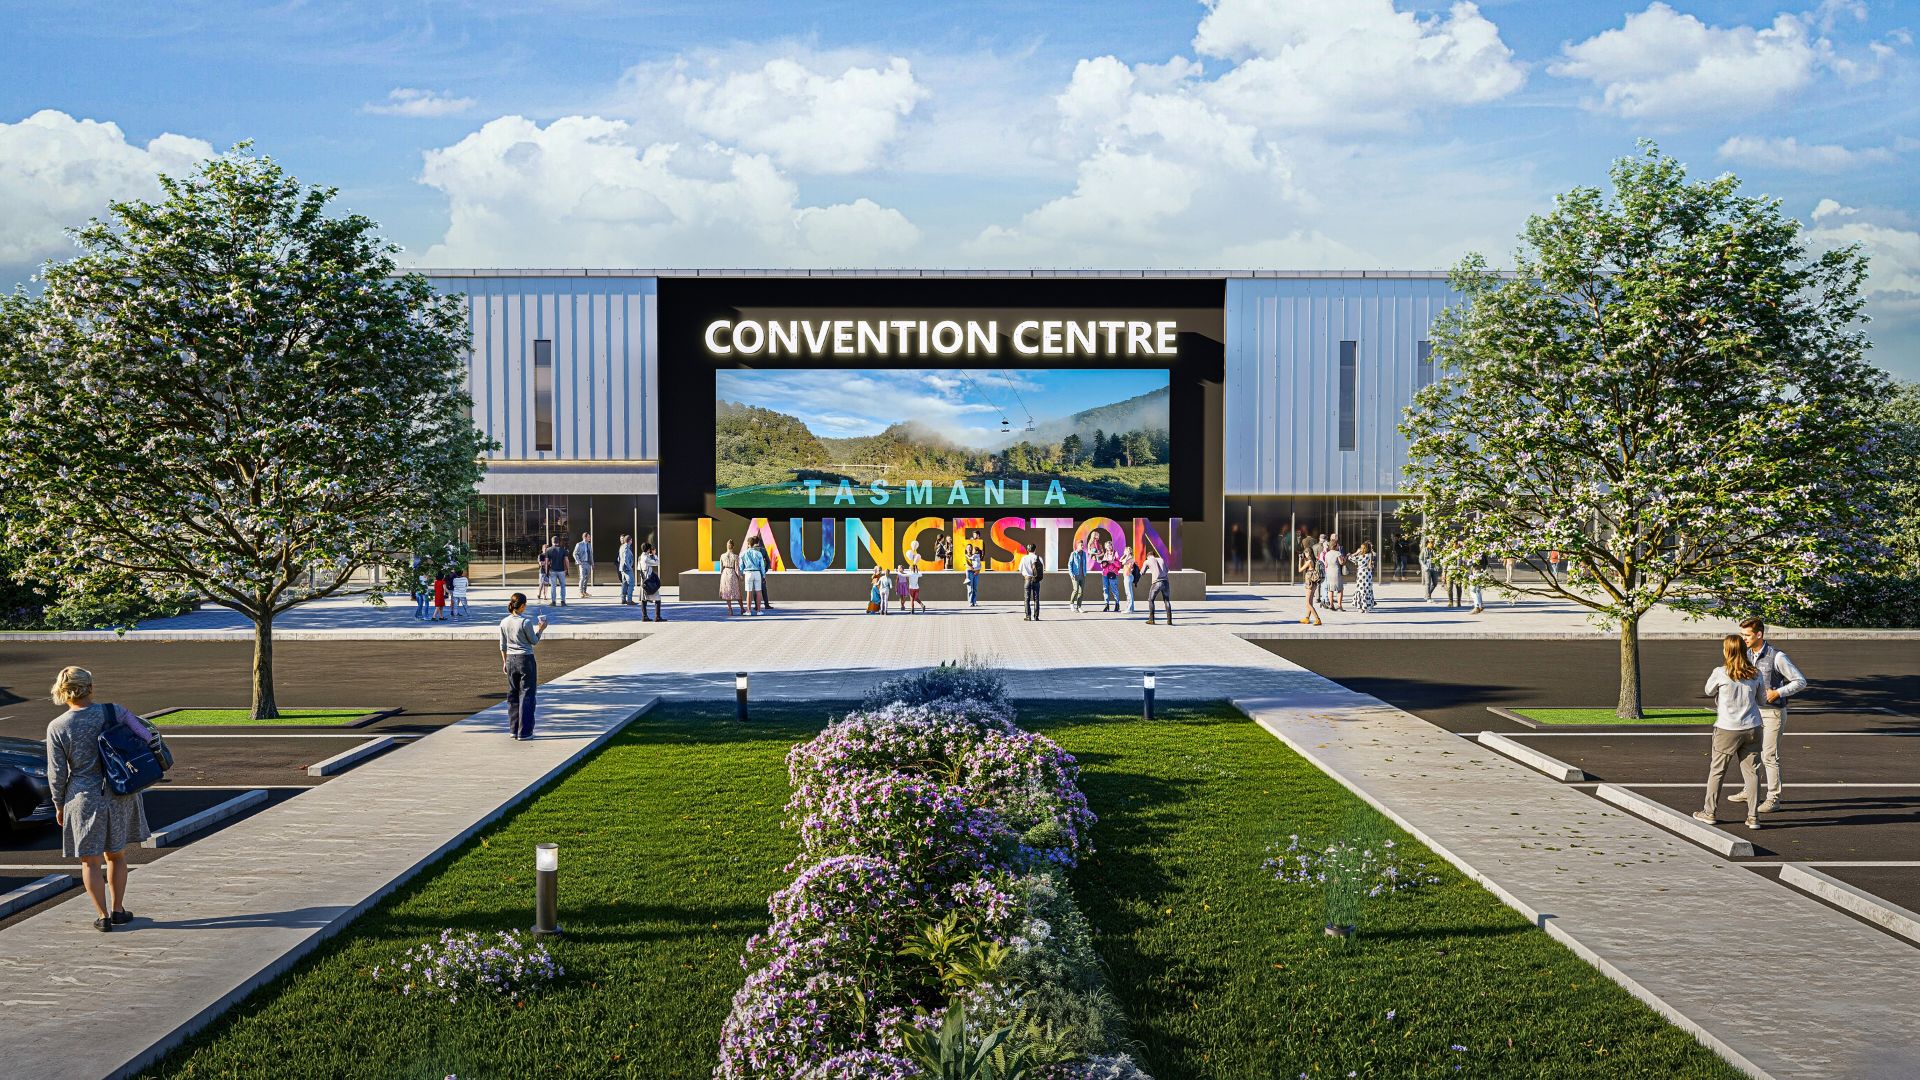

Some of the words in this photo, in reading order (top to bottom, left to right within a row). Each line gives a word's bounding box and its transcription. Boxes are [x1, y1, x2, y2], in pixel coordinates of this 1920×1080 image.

[704, 320, 997, 354] CONVENTION
[1013, 320, 1178, 355] CENTRE
[803, 480, 1067, 505] TASMANIA
[698, 517, 1182, 572] LAUNCESTON
